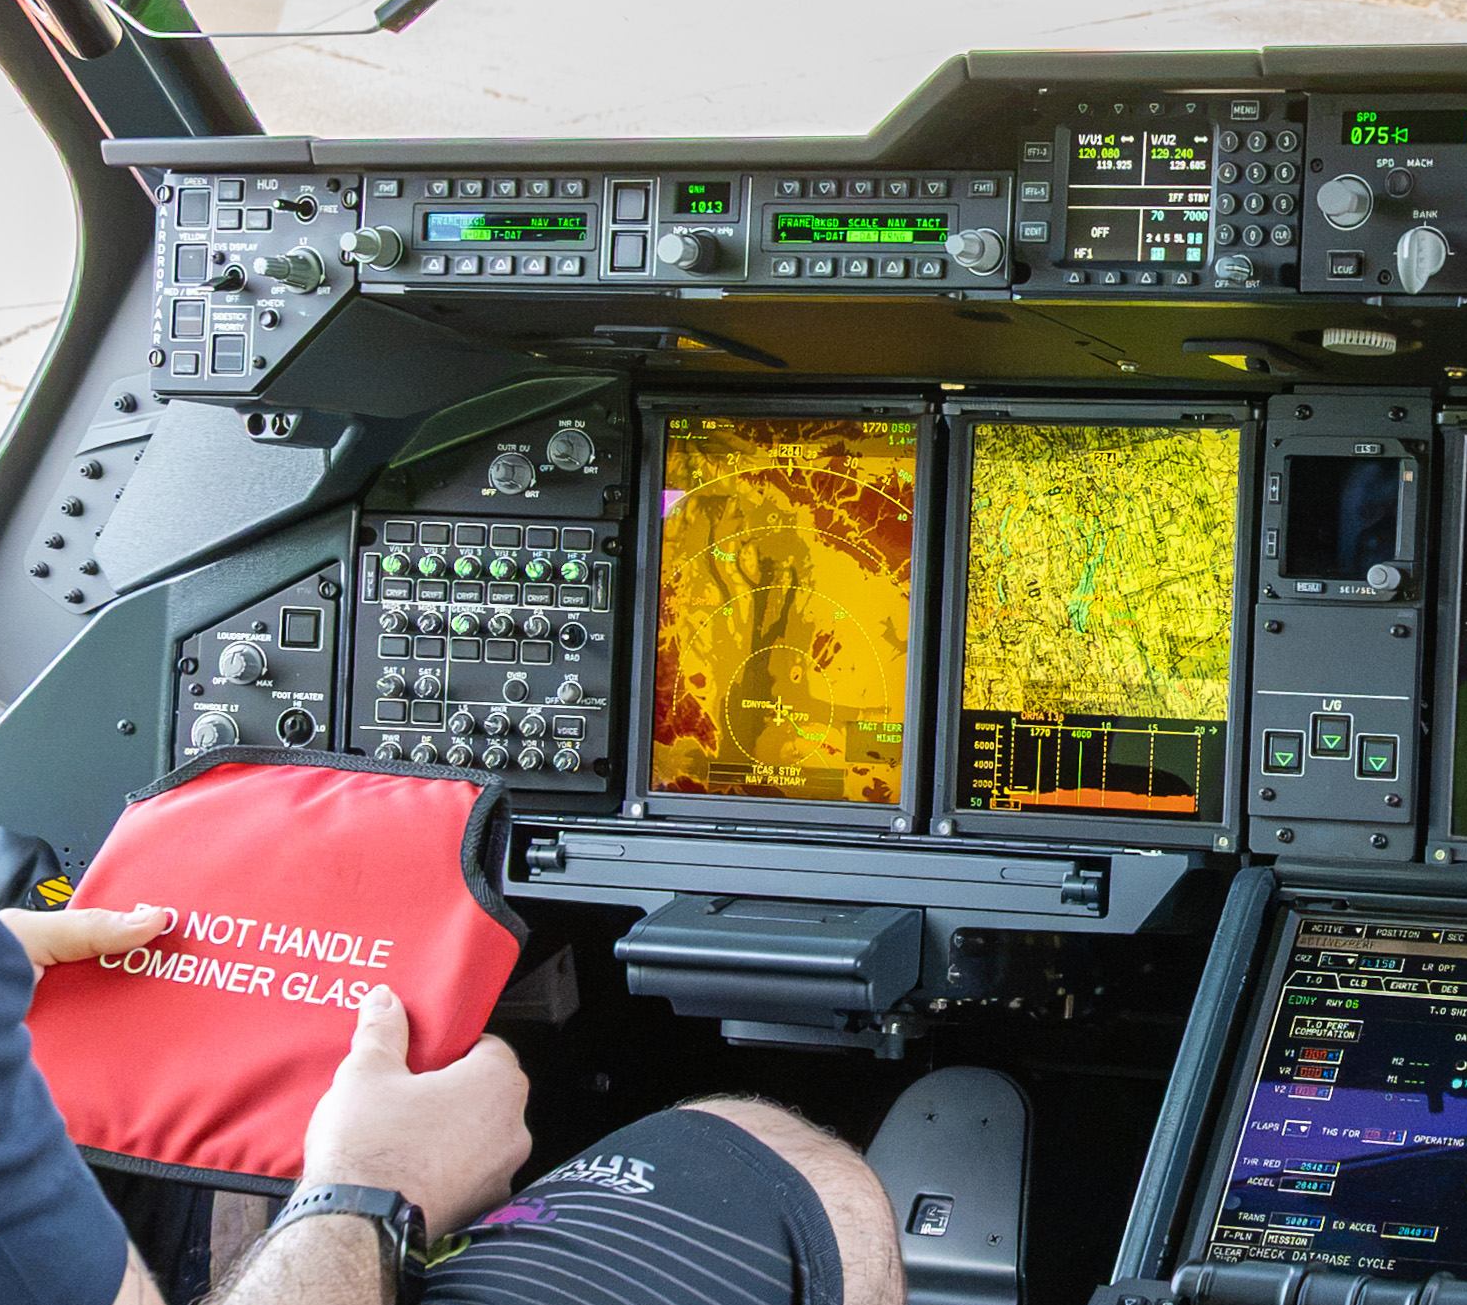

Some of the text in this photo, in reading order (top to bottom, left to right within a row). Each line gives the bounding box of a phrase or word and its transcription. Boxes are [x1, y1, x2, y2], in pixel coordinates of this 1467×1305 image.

[1356, 112, 1377, 123] SPD
[1351, 126, 1389, 144] 075
[1150, 148, 1194, 160] 129.240
[1407, 158, 1433, 169] MACH
[184, 177, 208, 185] GREEN
[257, 179, 279, 190] HUD
[1169, 192, 1209, 204] IFF STBY
[319, 205, 338, 213] FREE
[690, 201, 723, 214] 1013
[1183, 210, 1208, 222] 7000
[1413, 209, 1438, 220] BANK
[781, 217, 941, 228] FRAME BKGD SCALE NAV TACT
[179, 233, 207, 241] YELLOW
[813, 231, 844, 242] N-DAT
[1091, 227, 1110, 239] OFF
[214, 243, 258, 252] EVS DISPLAY
[212, 312, 247, 320] SIDESTICK
[214, 323, 244, 331] PRIORITY
[863, 422, 887, 434] 1770
[780, 446, 801, 456] 284
[1095, 452, 1117, 464] 284
[217, 632, 272, 643] LOUDSPEAKER
[272, 691, 324, 701] FOOT HEATER
[193, 703, 239, 712] CONSOLE LT
[1322, 699, 1342, 711] L/G
[1311, 924, 1344, 935] ACTIVE
[1376, 928, 1421, 939] POSITION
[184, 911, 257, 945] NOT
[261, 923, 394, 968] HANDLE
[1268, 1235, 1308, 1247] MISSION
[1249, 1247, 1396, 1271] CHECK DATABASE CYCLE
